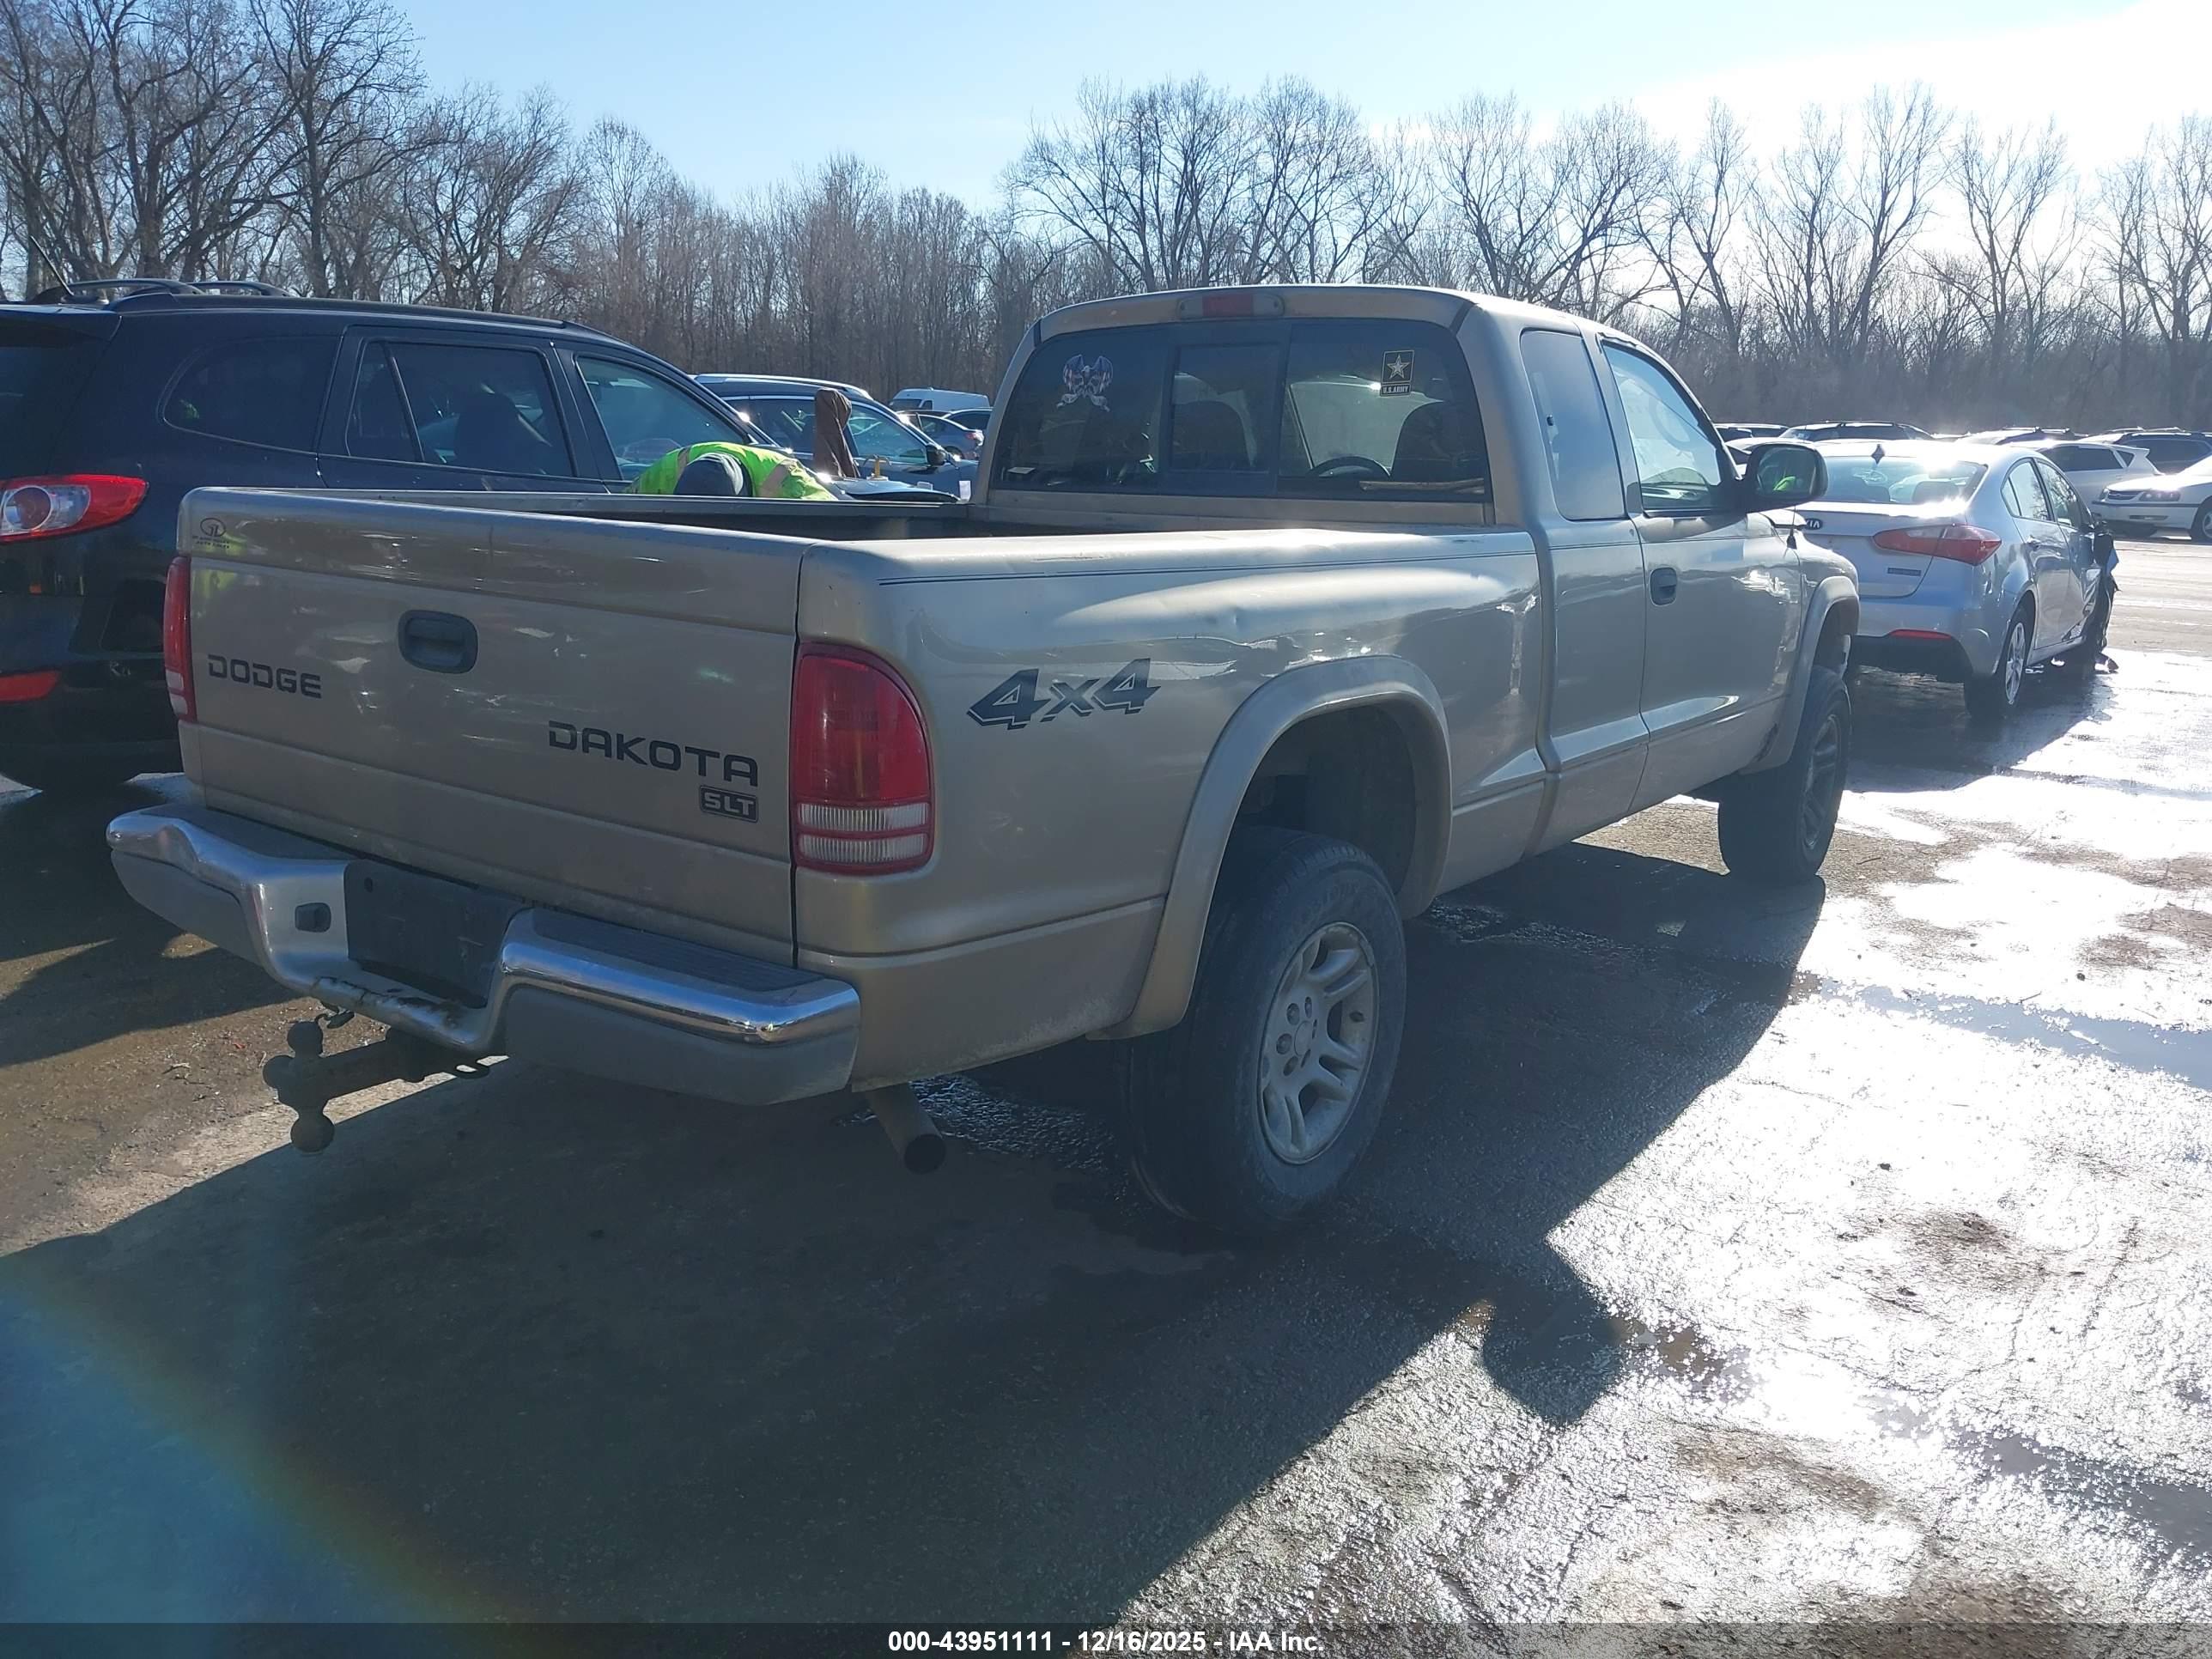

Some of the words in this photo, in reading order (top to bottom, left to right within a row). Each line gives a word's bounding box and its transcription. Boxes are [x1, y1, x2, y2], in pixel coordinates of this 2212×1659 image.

[208, 653, 322, 699] DODGE
[549, 720, 758, 787] DAKOTA
[704, 791, 755, 816] SLT
